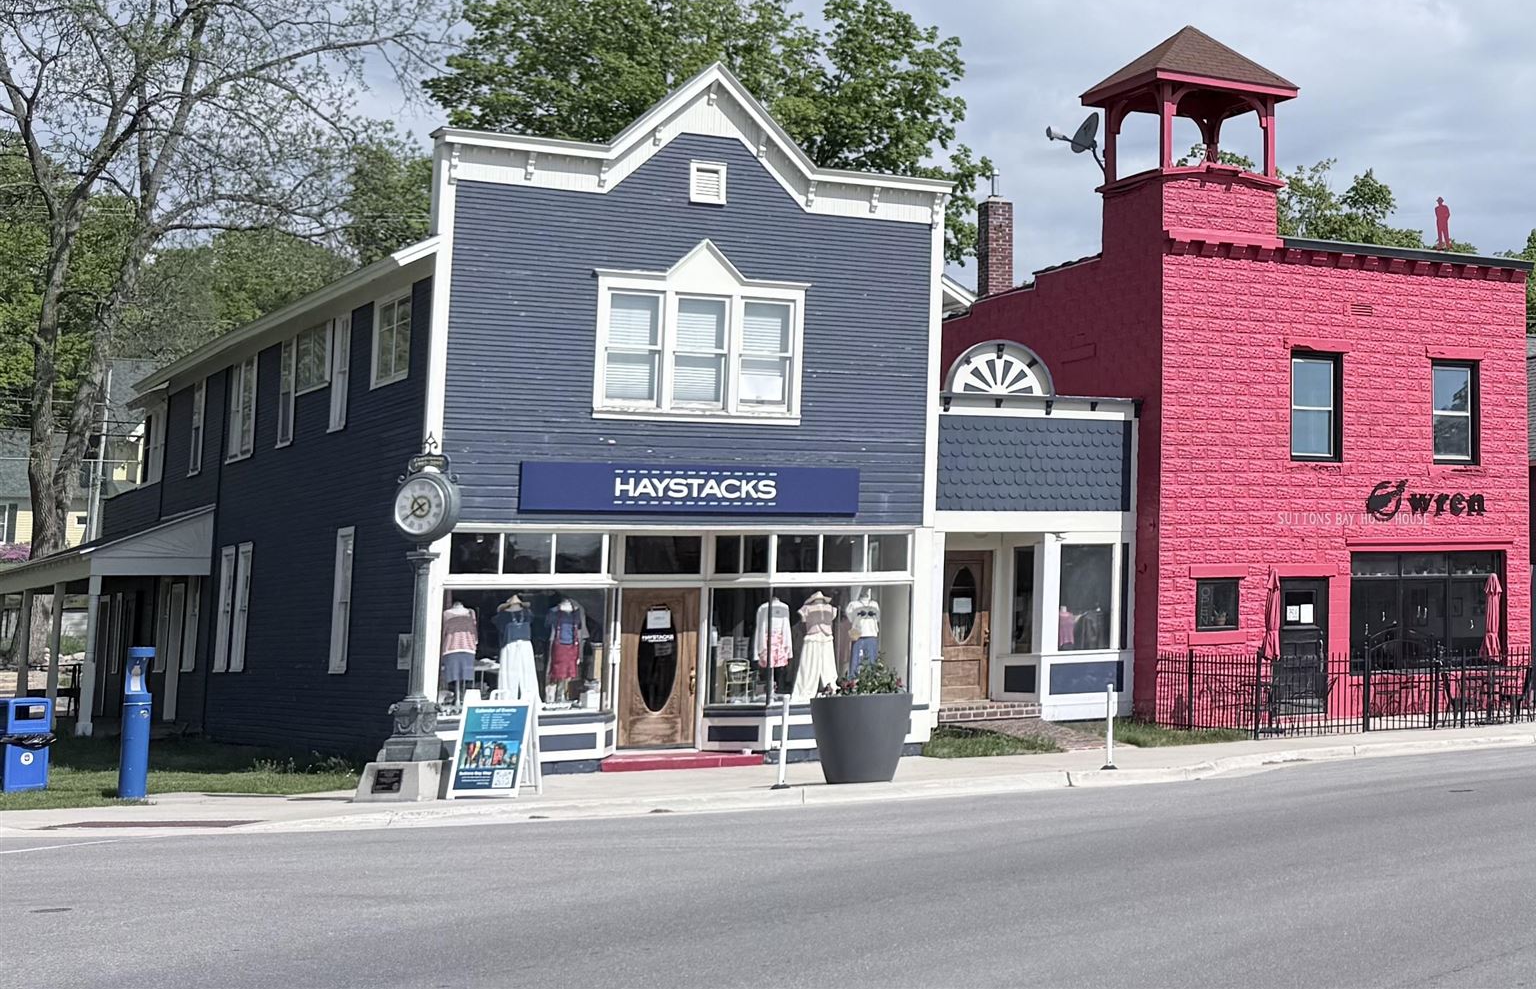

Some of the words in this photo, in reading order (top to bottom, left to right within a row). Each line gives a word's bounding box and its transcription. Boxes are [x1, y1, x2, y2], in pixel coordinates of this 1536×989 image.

[614, 477, 777, 499] HAYSTACKS
[1407, 491, 1487, 517] wren
[1277, 512, 1331, 525] SUTTONS
[1335, 512, 1355, 525] BAY
[1361, 513, 1389, 525] HO
[1395, 513, 1429, 525] HOUSE
[1200, 586, 1211, 625] OPEN
